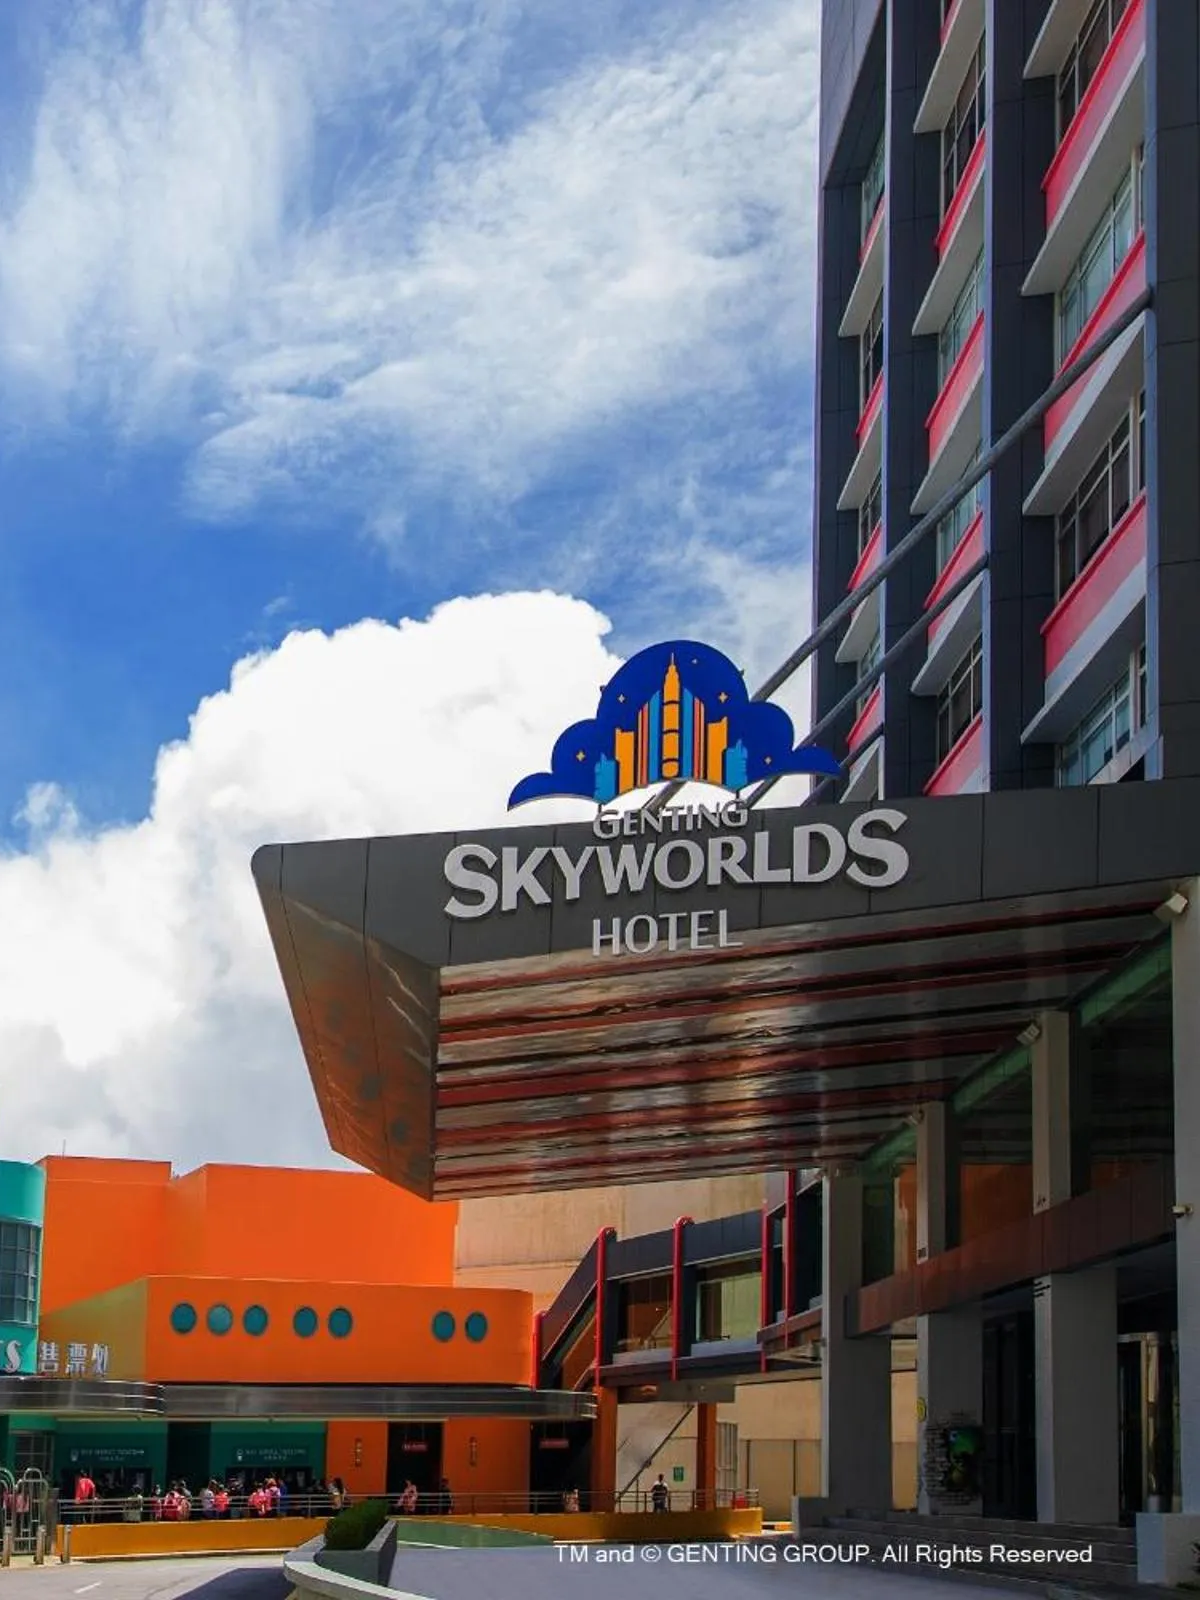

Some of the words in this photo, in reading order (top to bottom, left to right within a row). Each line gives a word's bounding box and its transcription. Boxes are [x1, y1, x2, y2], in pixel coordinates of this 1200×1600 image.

[592, 799, 748, 840] GENTING
[443, 808, 910, 919] SKYWORLDS
[591, 909, 743, 956] HOTEL
